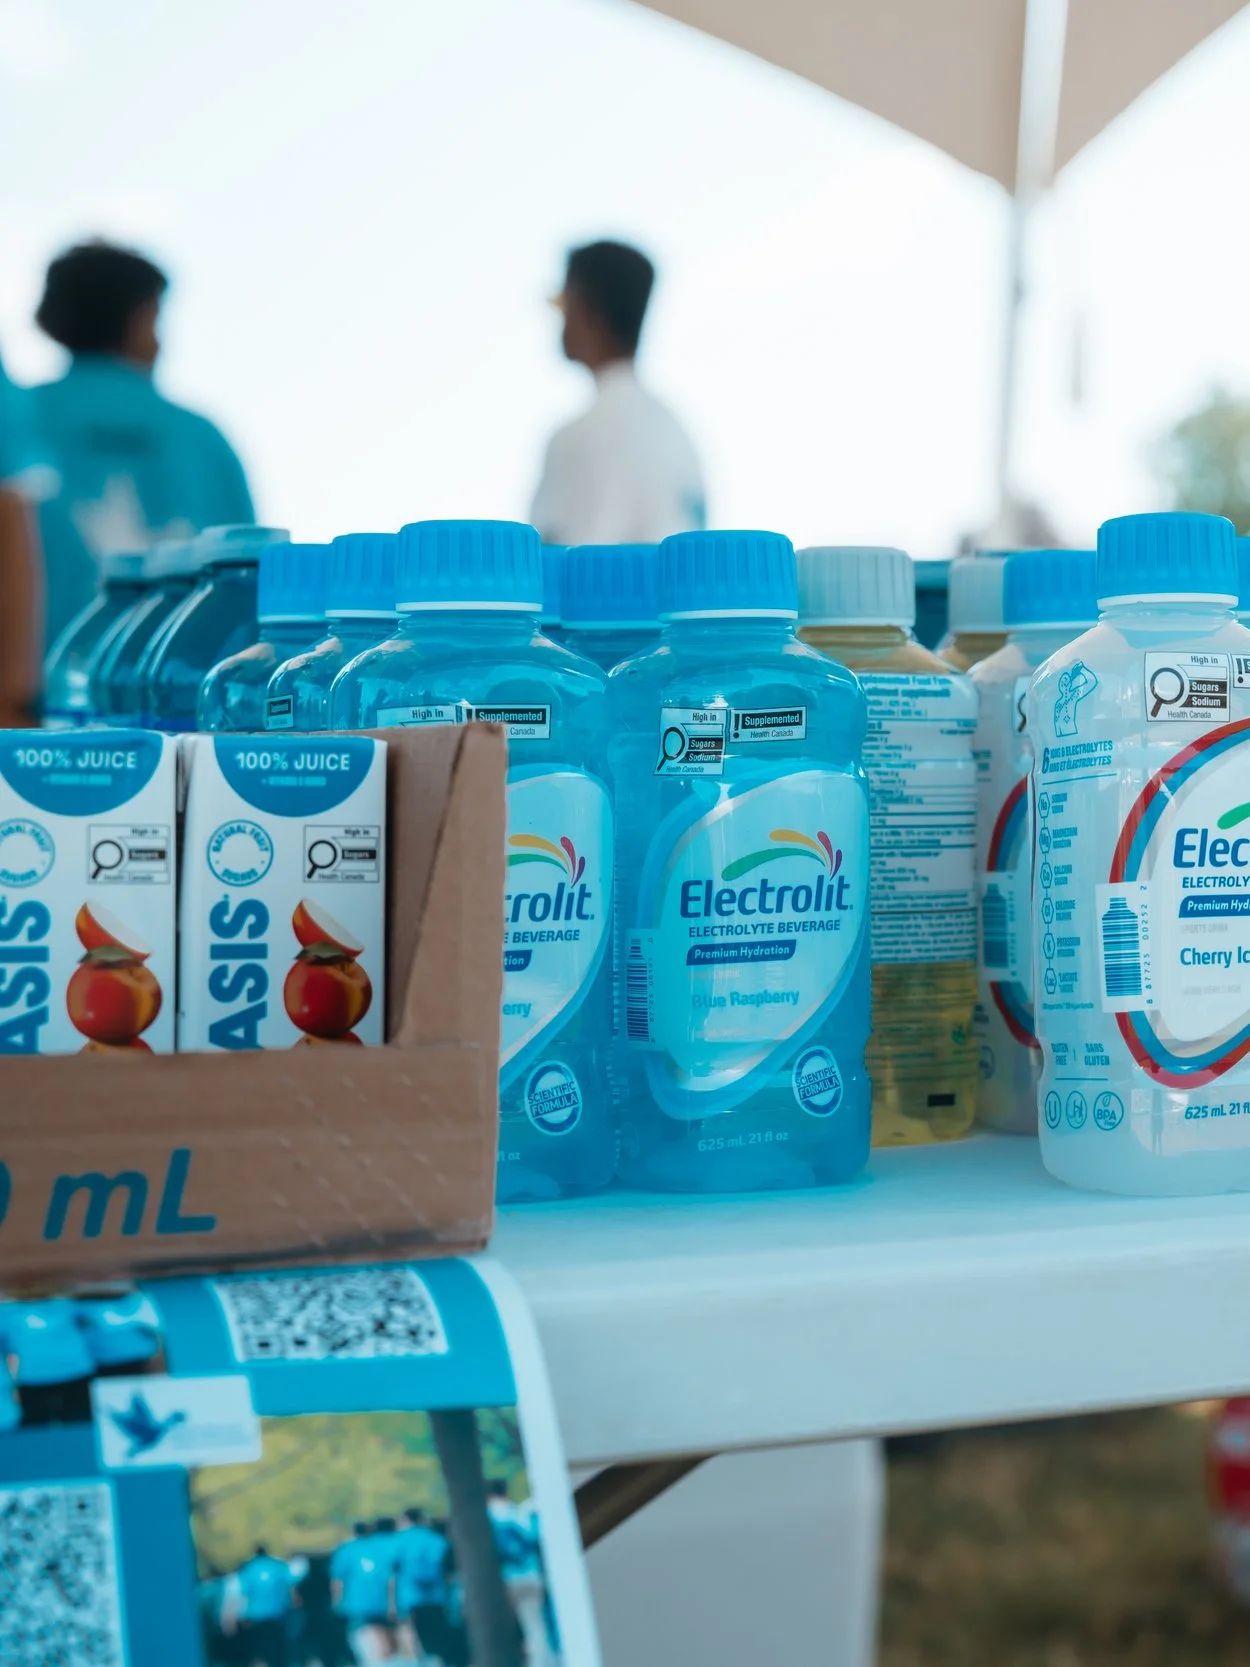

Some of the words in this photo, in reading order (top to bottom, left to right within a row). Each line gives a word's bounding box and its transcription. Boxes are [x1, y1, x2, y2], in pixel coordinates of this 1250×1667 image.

[1190, 655, 1210, 666] High
[1211, 656, 1219, 664] in
[1191, 682, 1219, 693] Sugars
[1191, 697, 1221, 707] Sodium
[412, 708, 433, 720] High
[434, 709, 444, 718] in
[478, 710, 543, 723] Supplemented
[692, 712, 709, 723] High
[710, 713, 717, 721] in
[744, 713, 800, 727] Supplemented
[1167, 710, 1188, 719] Health
[1189, 710, 1212, 719] Canada
[510, 726, 536, 736] Canada
[750, 730, 770, 739] Health
[771, 729, 794, 738] Canada
[690, 739, 716, 749] Sugars
[1066, 740, 1113, 757] ELECTROLYTES
[15, 750, 71, 768] 100%
[78, 750, 137, 769] JUICE
[235, 752, 289, 770] 100%
[294, 753, 350, 771] JUICE
[688, 753, 716, 762] Sodium
[682, 765, 705, 773] Canada
[343, 850, 370, 859] Sugars
[1187, 900, 1229, 912] Premium
[688, 922, 774, 938] ELECTROLYTE
[777, 919, 841, 934] BEVERAGE
[512, 929, 581, 944] BEVERAGE
[694, 947, 738, 960] Premium
[739, 944, 790, 960] Hydration
[1180, 947, 1233, 968] Cherry
[691, 993, 727, 1009] Blue
[729, 989, 800, 1009] Raspberry
[795, 1065, 837, 1088] SCIENTIFIC
[527, 1081, 576, 1105] SCIENTIFIC
[799, 1076, 841, 1100] FORMULA
[531, 1092, 579, 1117] FORMULA
[1184, 1105, 1209, 1120] 625
[1211, 1104, 1227, 1117] mL
[1229, 1102, 1241, 1115] 21
[1096, 1108, 1117, 1121] BPA
[697, 1137, 725, 1151] 625
[727, 1135, 746, 1147] mL
[749, 1132, 762, 1144] 21
[764, 1130, 773, 1142] fl
[776, 1131, 789, 1141] oz
[508, 1152, 521, 1161] oz
[42, 1147, 218, 1241] mL
